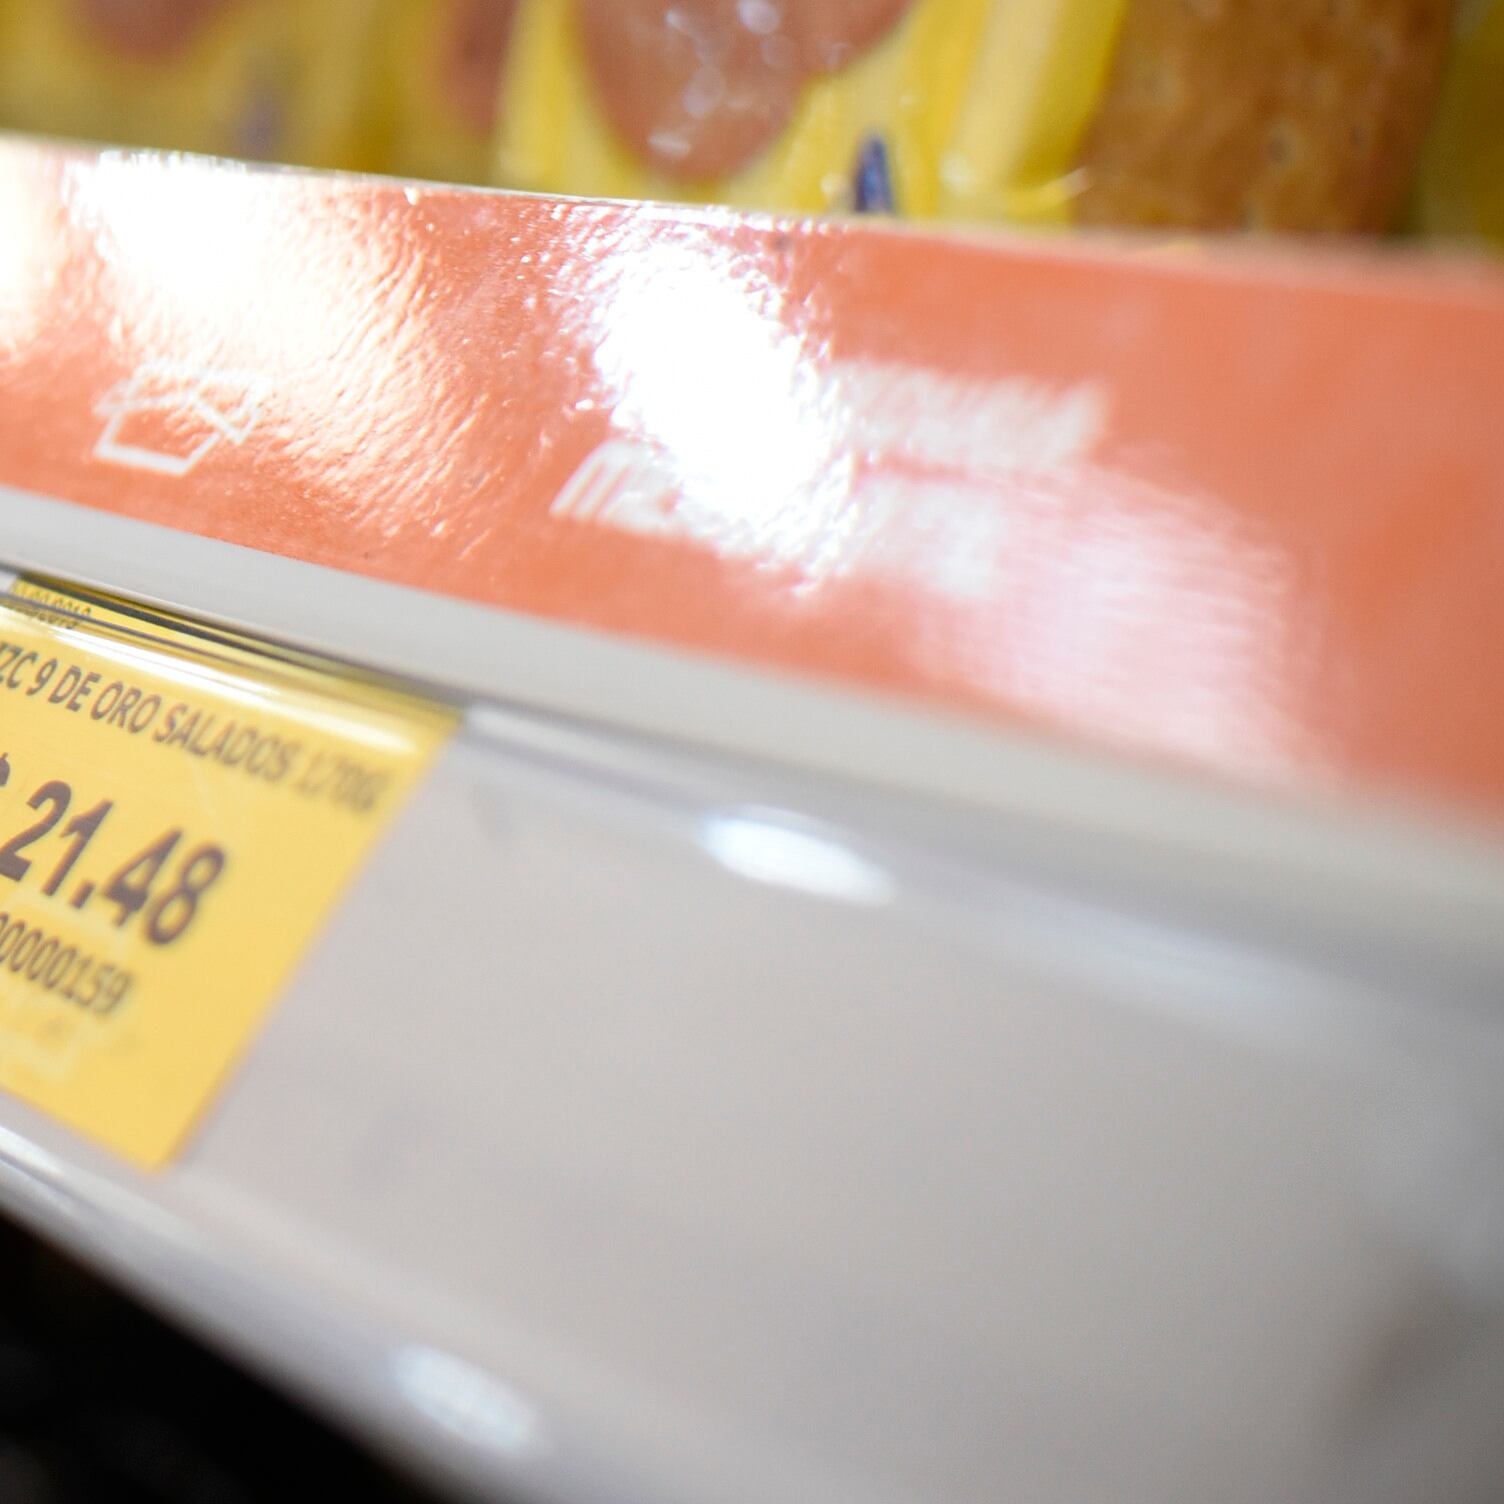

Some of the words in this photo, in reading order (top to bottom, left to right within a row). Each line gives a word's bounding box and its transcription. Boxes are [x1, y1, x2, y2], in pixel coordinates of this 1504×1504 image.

[26, 658, 58, 696] 9
[47, 665, 102, 712] DE
[90, 681, 162, 733] ORO
[151, 703, 302, 782] SALADOS
